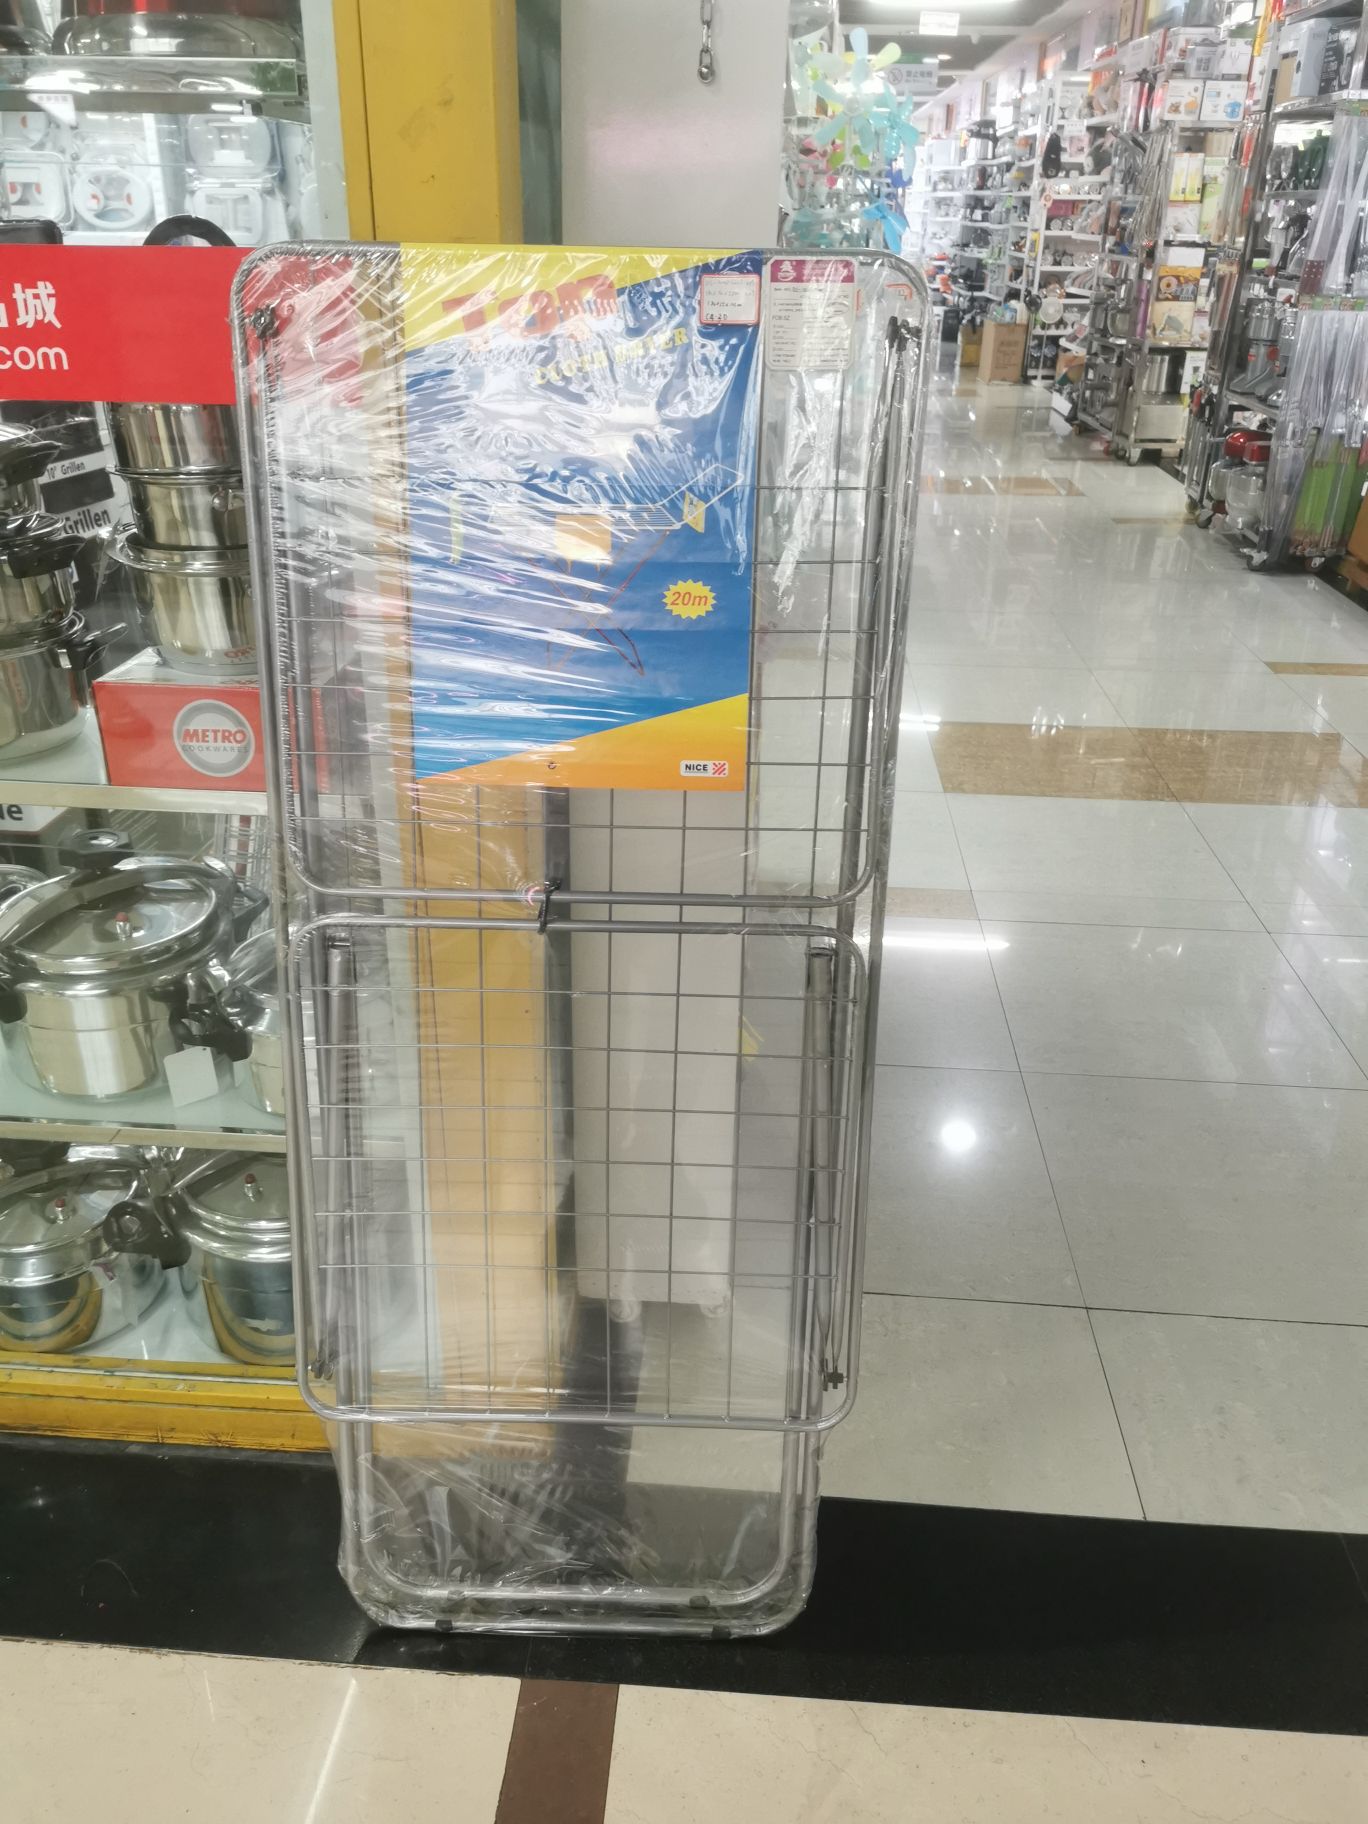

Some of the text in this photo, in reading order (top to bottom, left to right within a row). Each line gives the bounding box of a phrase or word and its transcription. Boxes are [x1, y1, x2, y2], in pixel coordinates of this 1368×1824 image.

[61, 461, 86, 475] Grillen
[62, 508, 111, 535] Grillen
[670, 591, 708, 606] 20m
[182, 729, 247, 744] METRO
[685, 763, 709, 771] NICE
